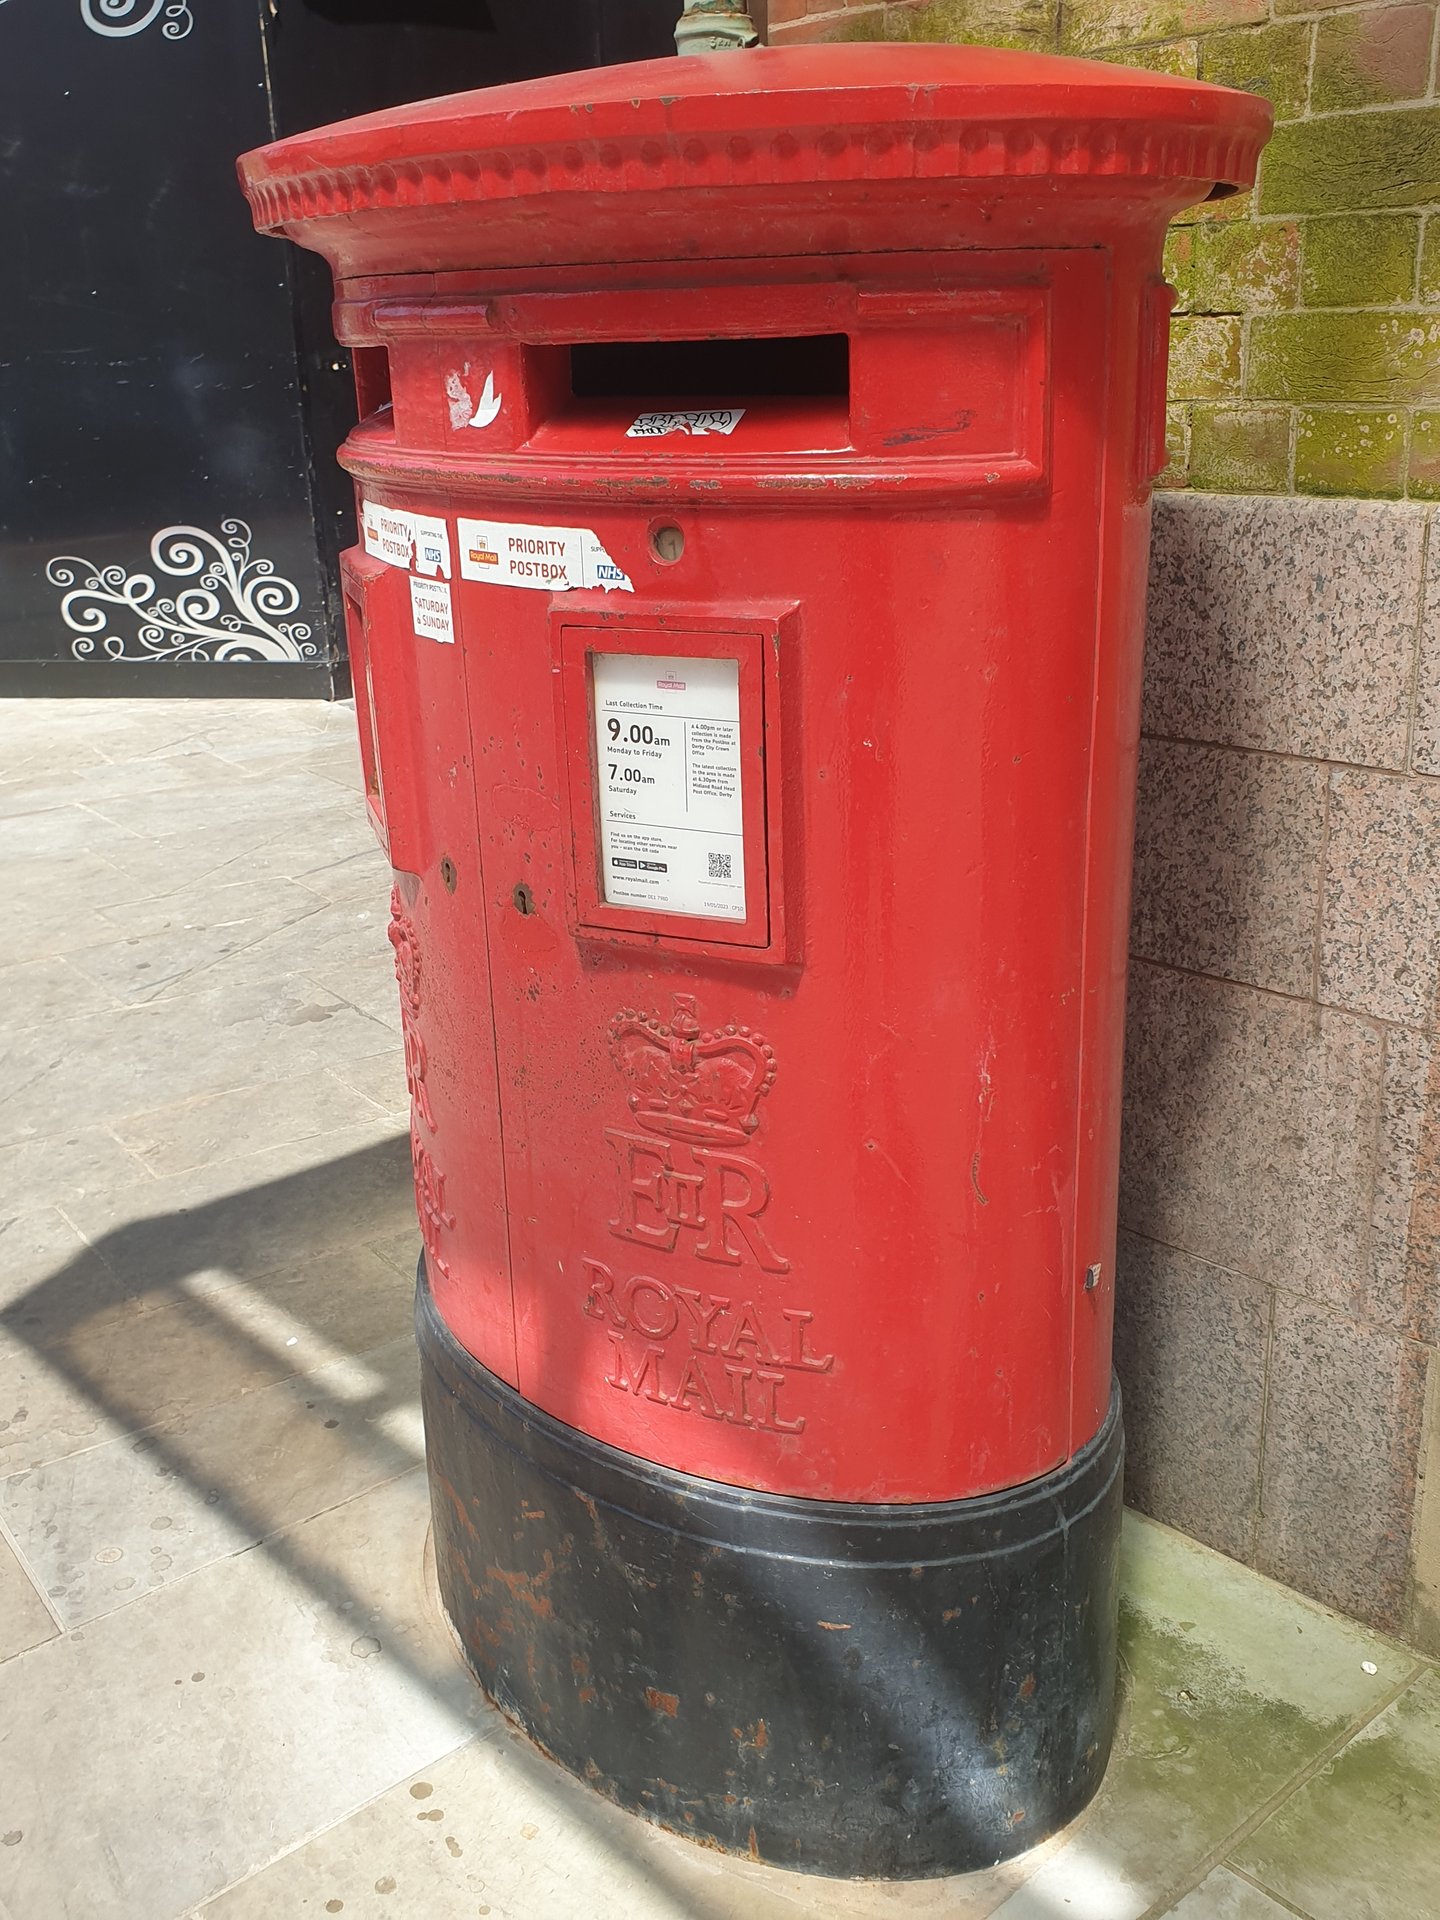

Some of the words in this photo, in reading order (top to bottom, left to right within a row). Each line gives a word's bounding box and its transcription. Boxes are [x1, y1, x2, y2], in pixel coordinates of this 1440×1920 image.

[380, 518, 408, 538] PRIORITY
[382, 538, 410, 558] POSTBOX
[426, 549, 441, 562] NHS
[508, 538, 566, 556] PRIORITY
[470, 551, 484, 562] Royal
[485, 553, 498, 562] Mail
[510, 560, 568, 580] POSTBOX
[598, 567, 624, 580] NHS
[414, 597, 448, 614] SATURDAY
[422, 614, 449, 631] SUNDAY
[619, 701, 647, 709] Collection
[607, 718, 670, 746] 9.00am
[607, 746, 631, 756] Monday
[642, 750, 662, 758] Friday
[608, 764, 655, 784] 7.00am
[608, 786, 637, 796] Saturday
[609, 810, 636, 820] Services
[612, 875, 659, 885] www.royalmail.com
[582, 1256, 835, 1373] ROYAL
[603, 1329, 806, 1435] MAIL
